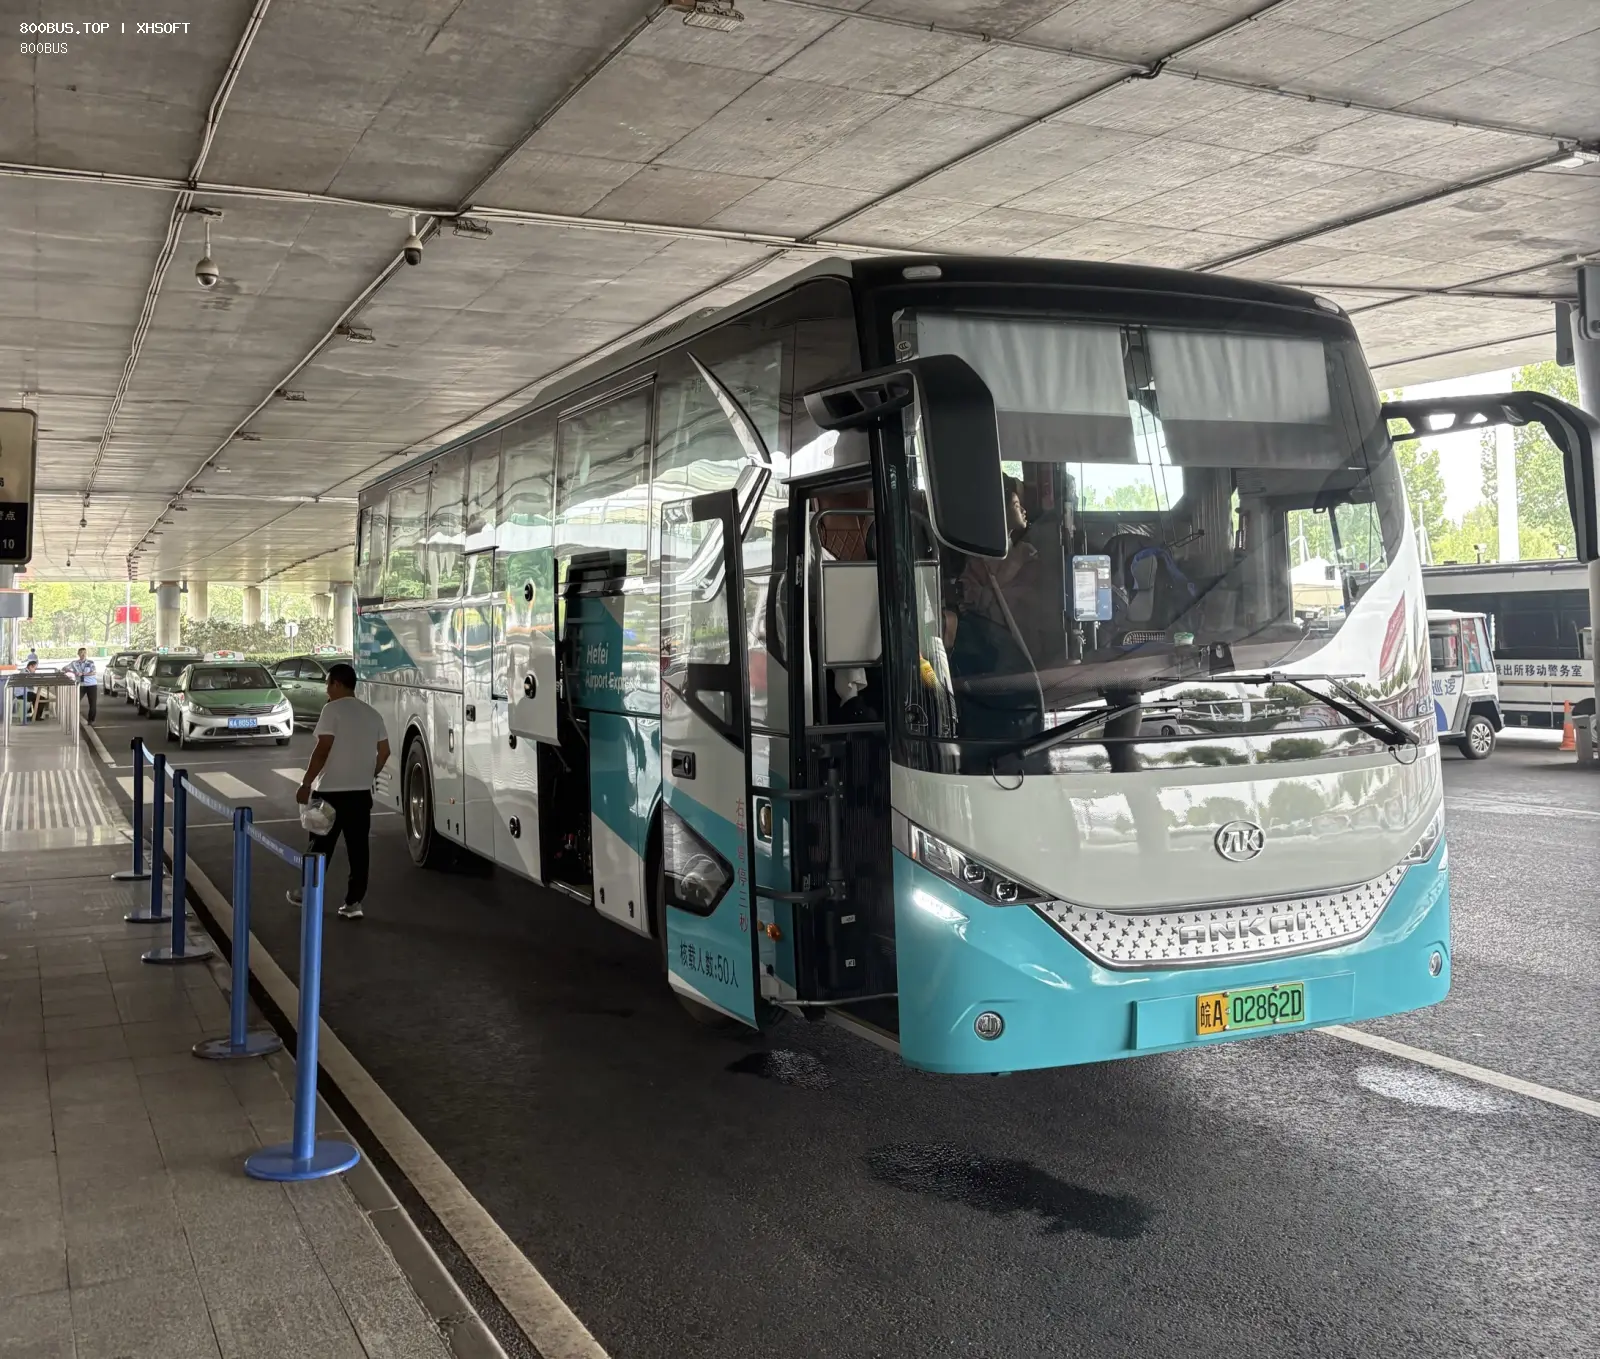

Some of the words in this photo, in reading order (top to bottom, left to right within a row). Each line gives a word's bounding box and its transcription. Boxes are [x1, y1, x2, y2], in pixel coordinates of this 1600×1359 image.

[586, 642, 609, 665] Hefei
[585, 670, 608, 694] Airport
[1431, 677, 1457, 696] 巡逻
[1178, 911, 1307, 946] ANKAI
[680, 940, 739, 989] 核载人数:50人
[1232, 988, 1303, 1024] 02862D
